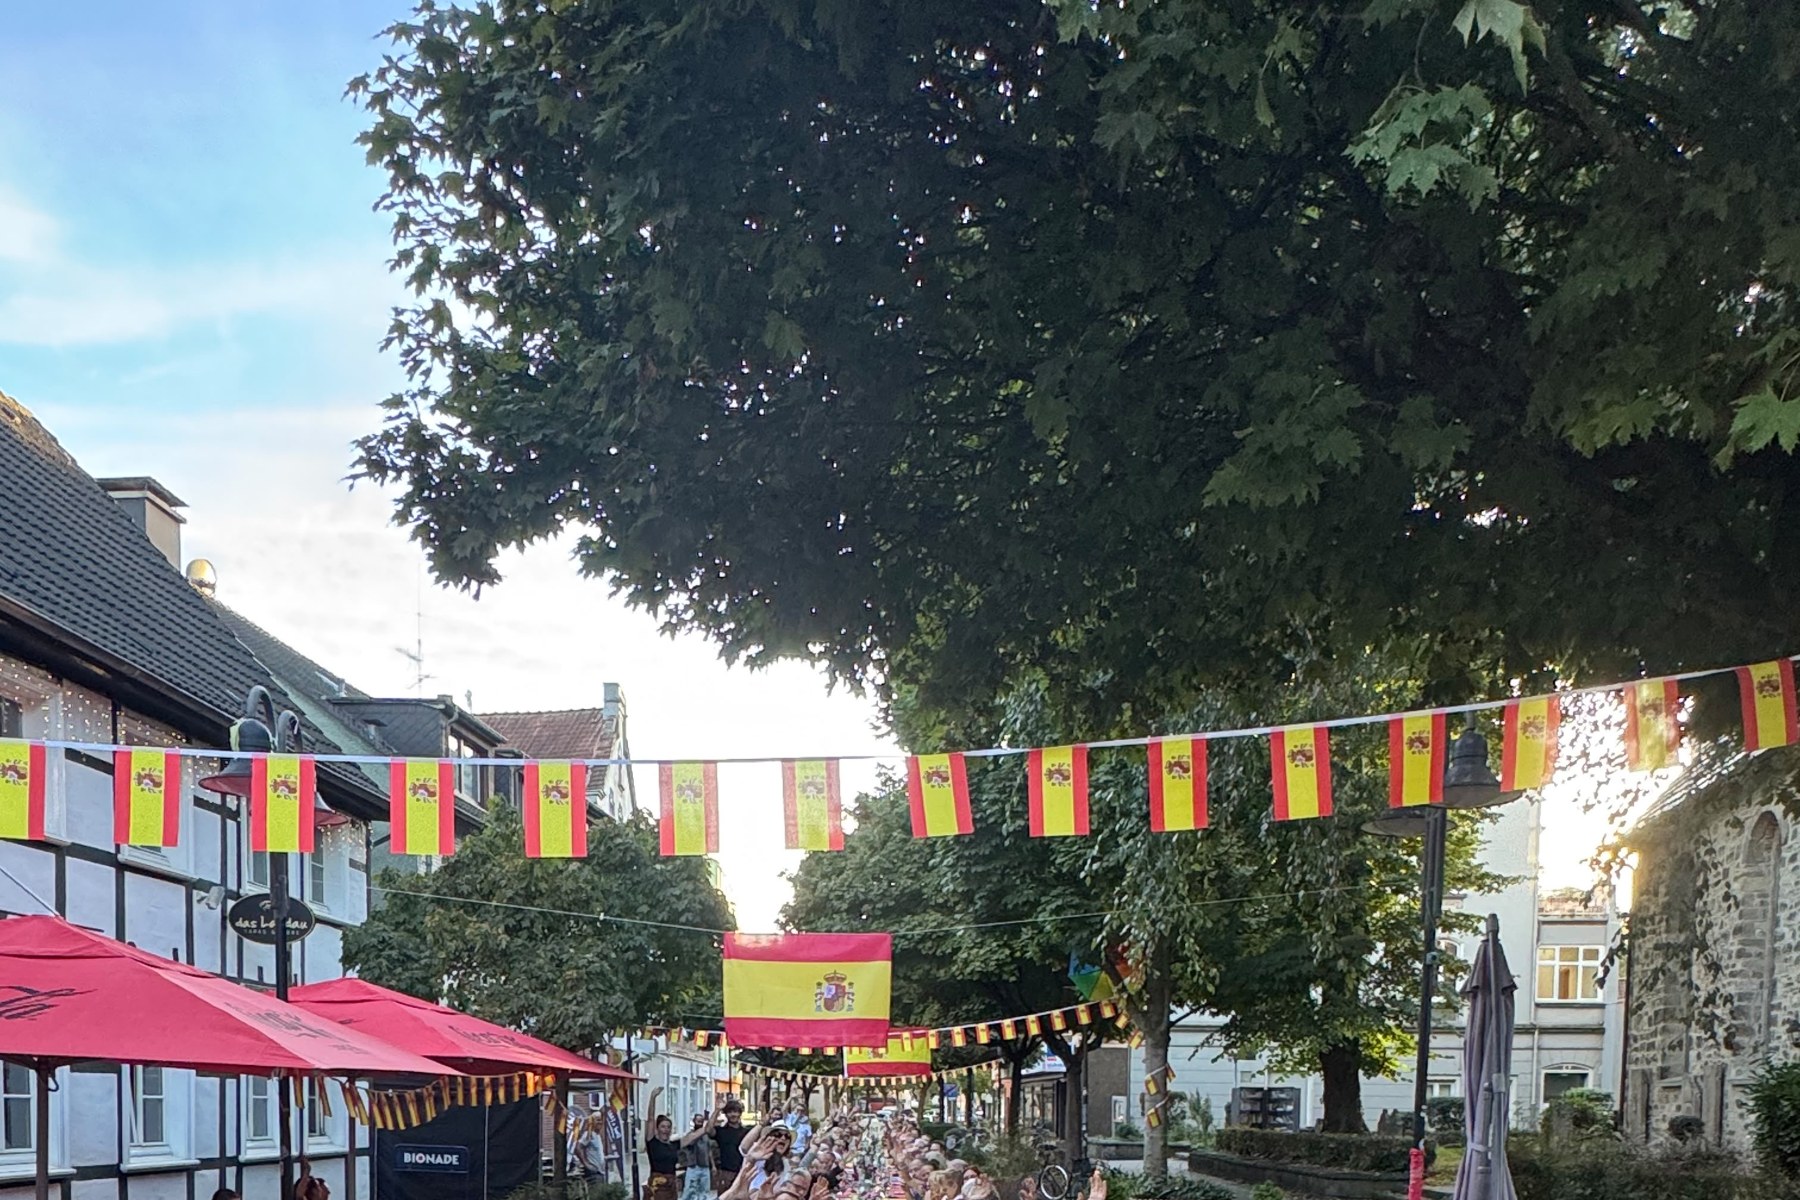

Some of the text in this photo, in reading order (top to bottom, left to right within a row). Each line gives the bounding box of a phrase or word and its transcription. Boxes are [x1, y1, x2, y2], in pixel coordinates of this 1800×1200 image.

[235, 915, 308, 930] das Ladau
[404, 1152, 460, 1165] BIONADE
